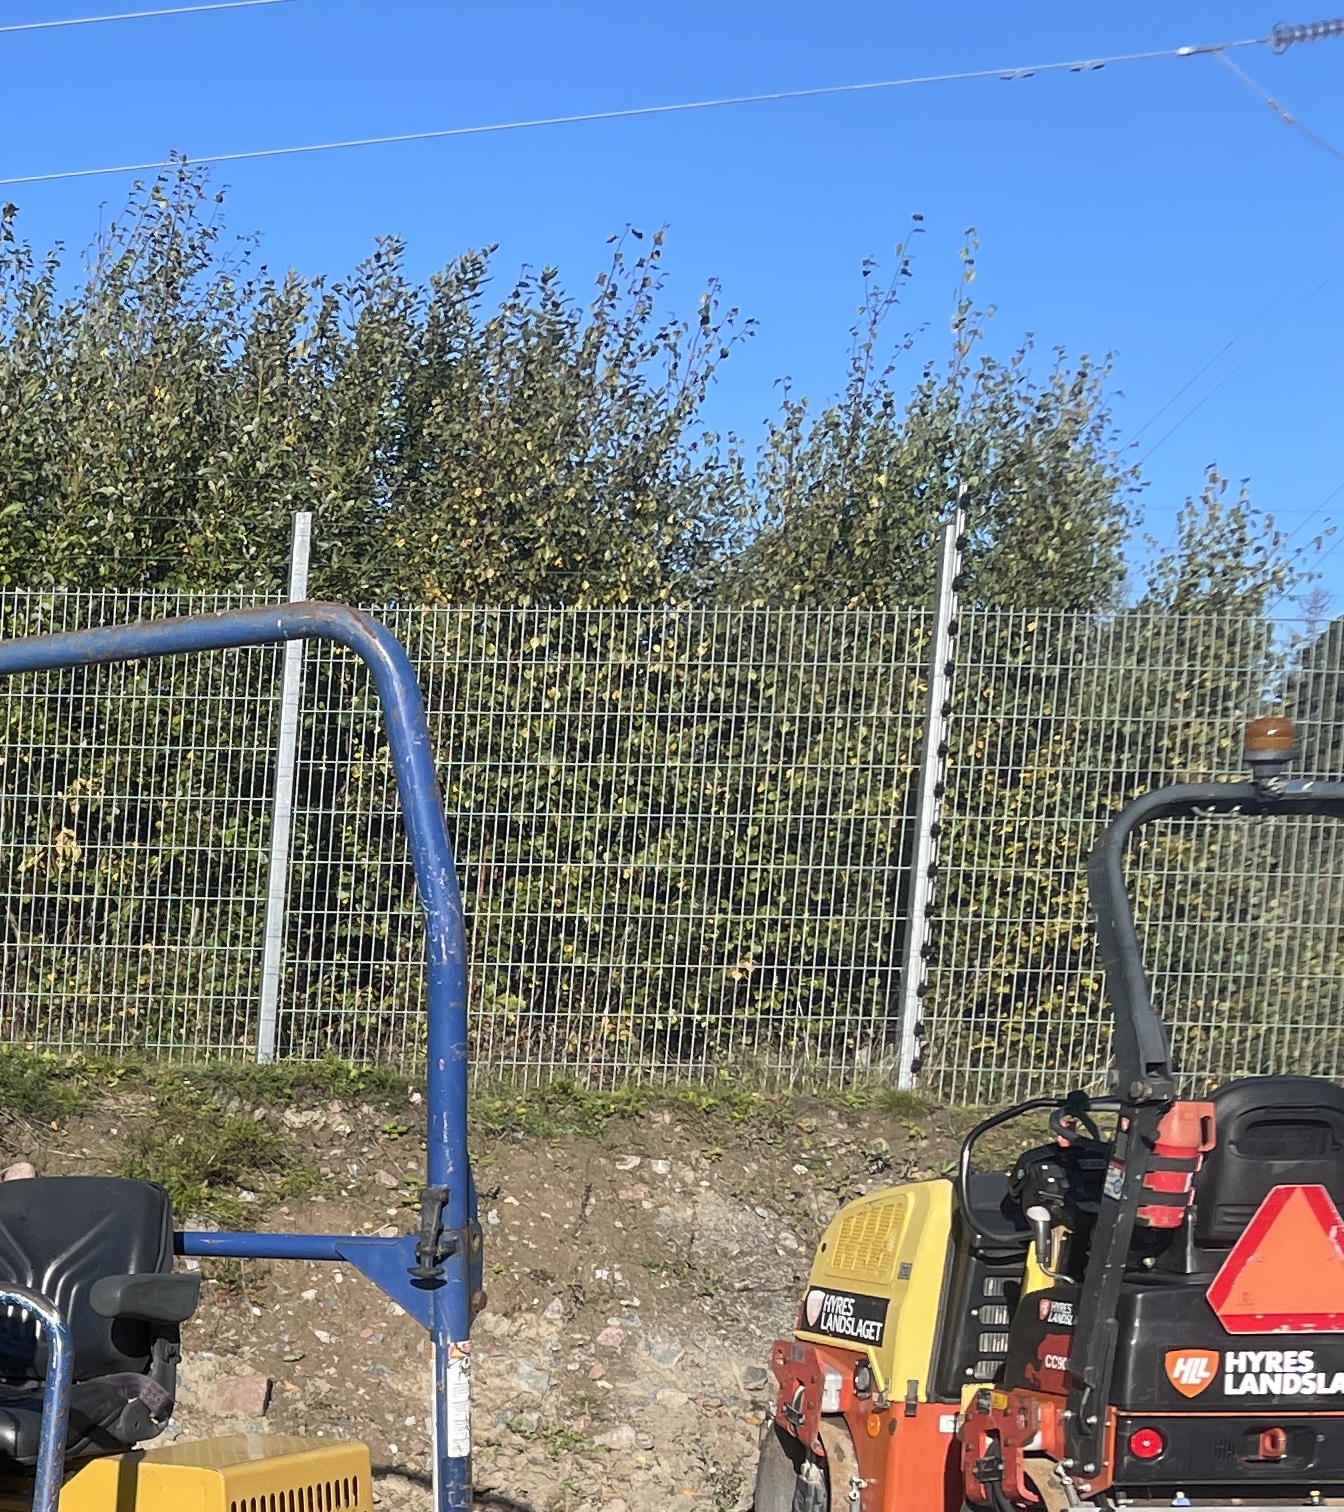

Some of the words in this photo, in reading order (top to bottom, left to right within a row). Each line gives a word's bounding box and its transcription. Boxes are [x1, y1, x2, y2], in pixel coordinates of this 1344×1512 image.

[823, 1294, 856, 1316] HYRES
[820, 1312, 883, 1341] LANDSLAGET
[1225, 1350, 1314, 1373] HYRES
